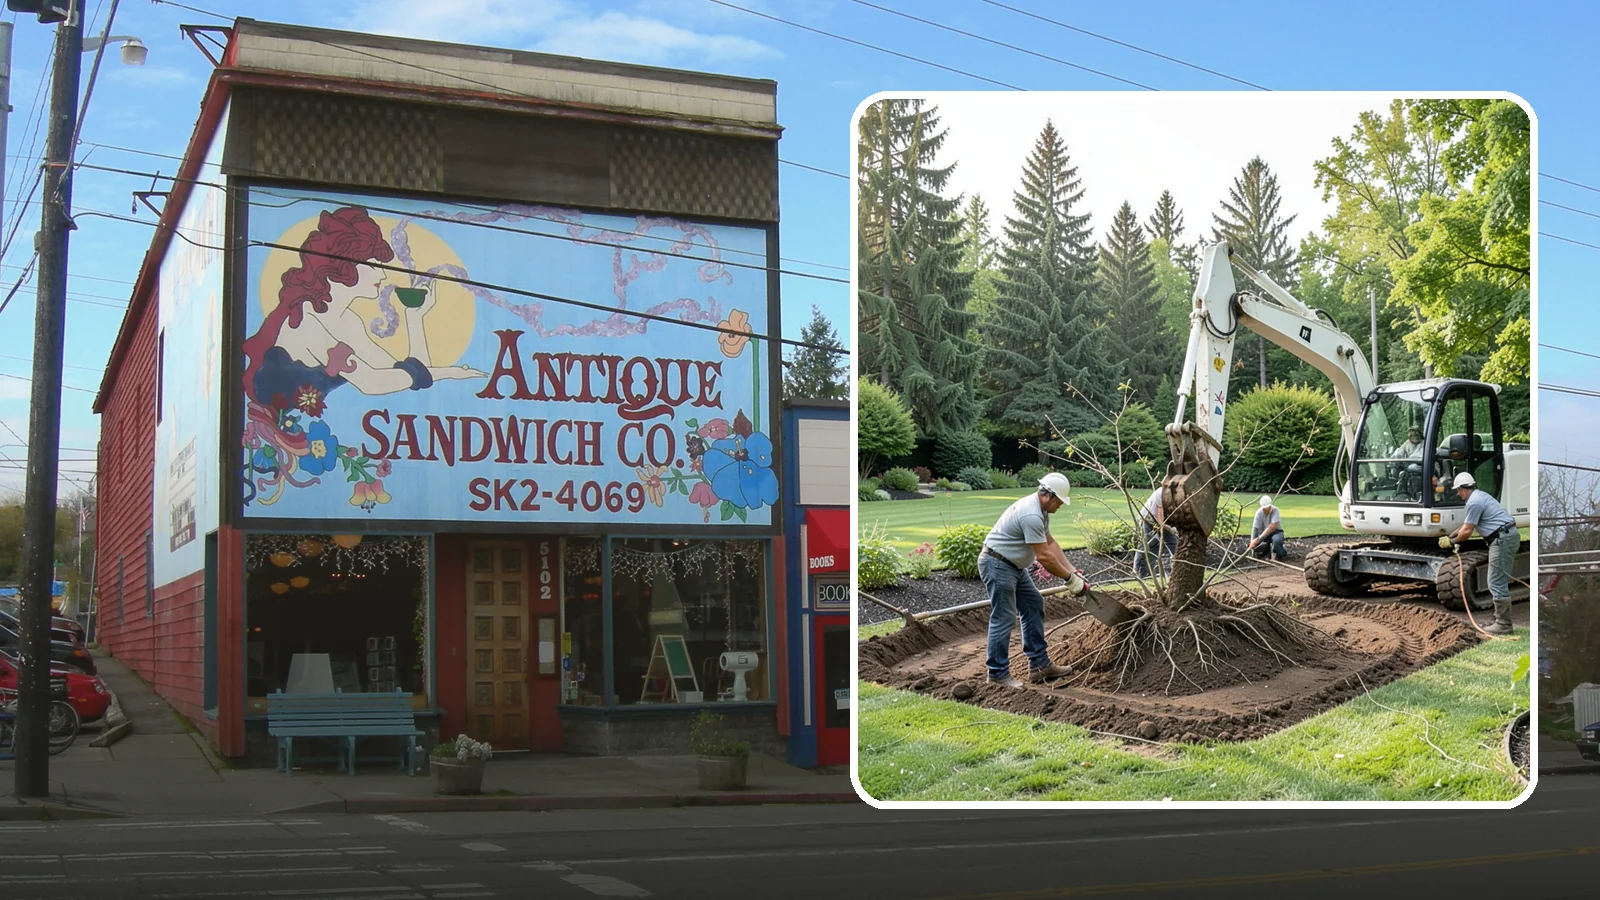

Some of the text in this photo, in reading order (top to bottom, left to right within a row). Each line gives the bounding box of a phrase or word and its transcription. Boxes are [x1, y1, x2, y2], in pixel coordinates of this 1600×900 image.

[476, 329, 723, 420] ANTIQUE
[361, 409, 685, 468] SANDWICH CO.
[468, 477, 646, 513] SK2-4069
[540, 542, 551, 599] 5102
[809, 555, 835, 569] BOOKS
